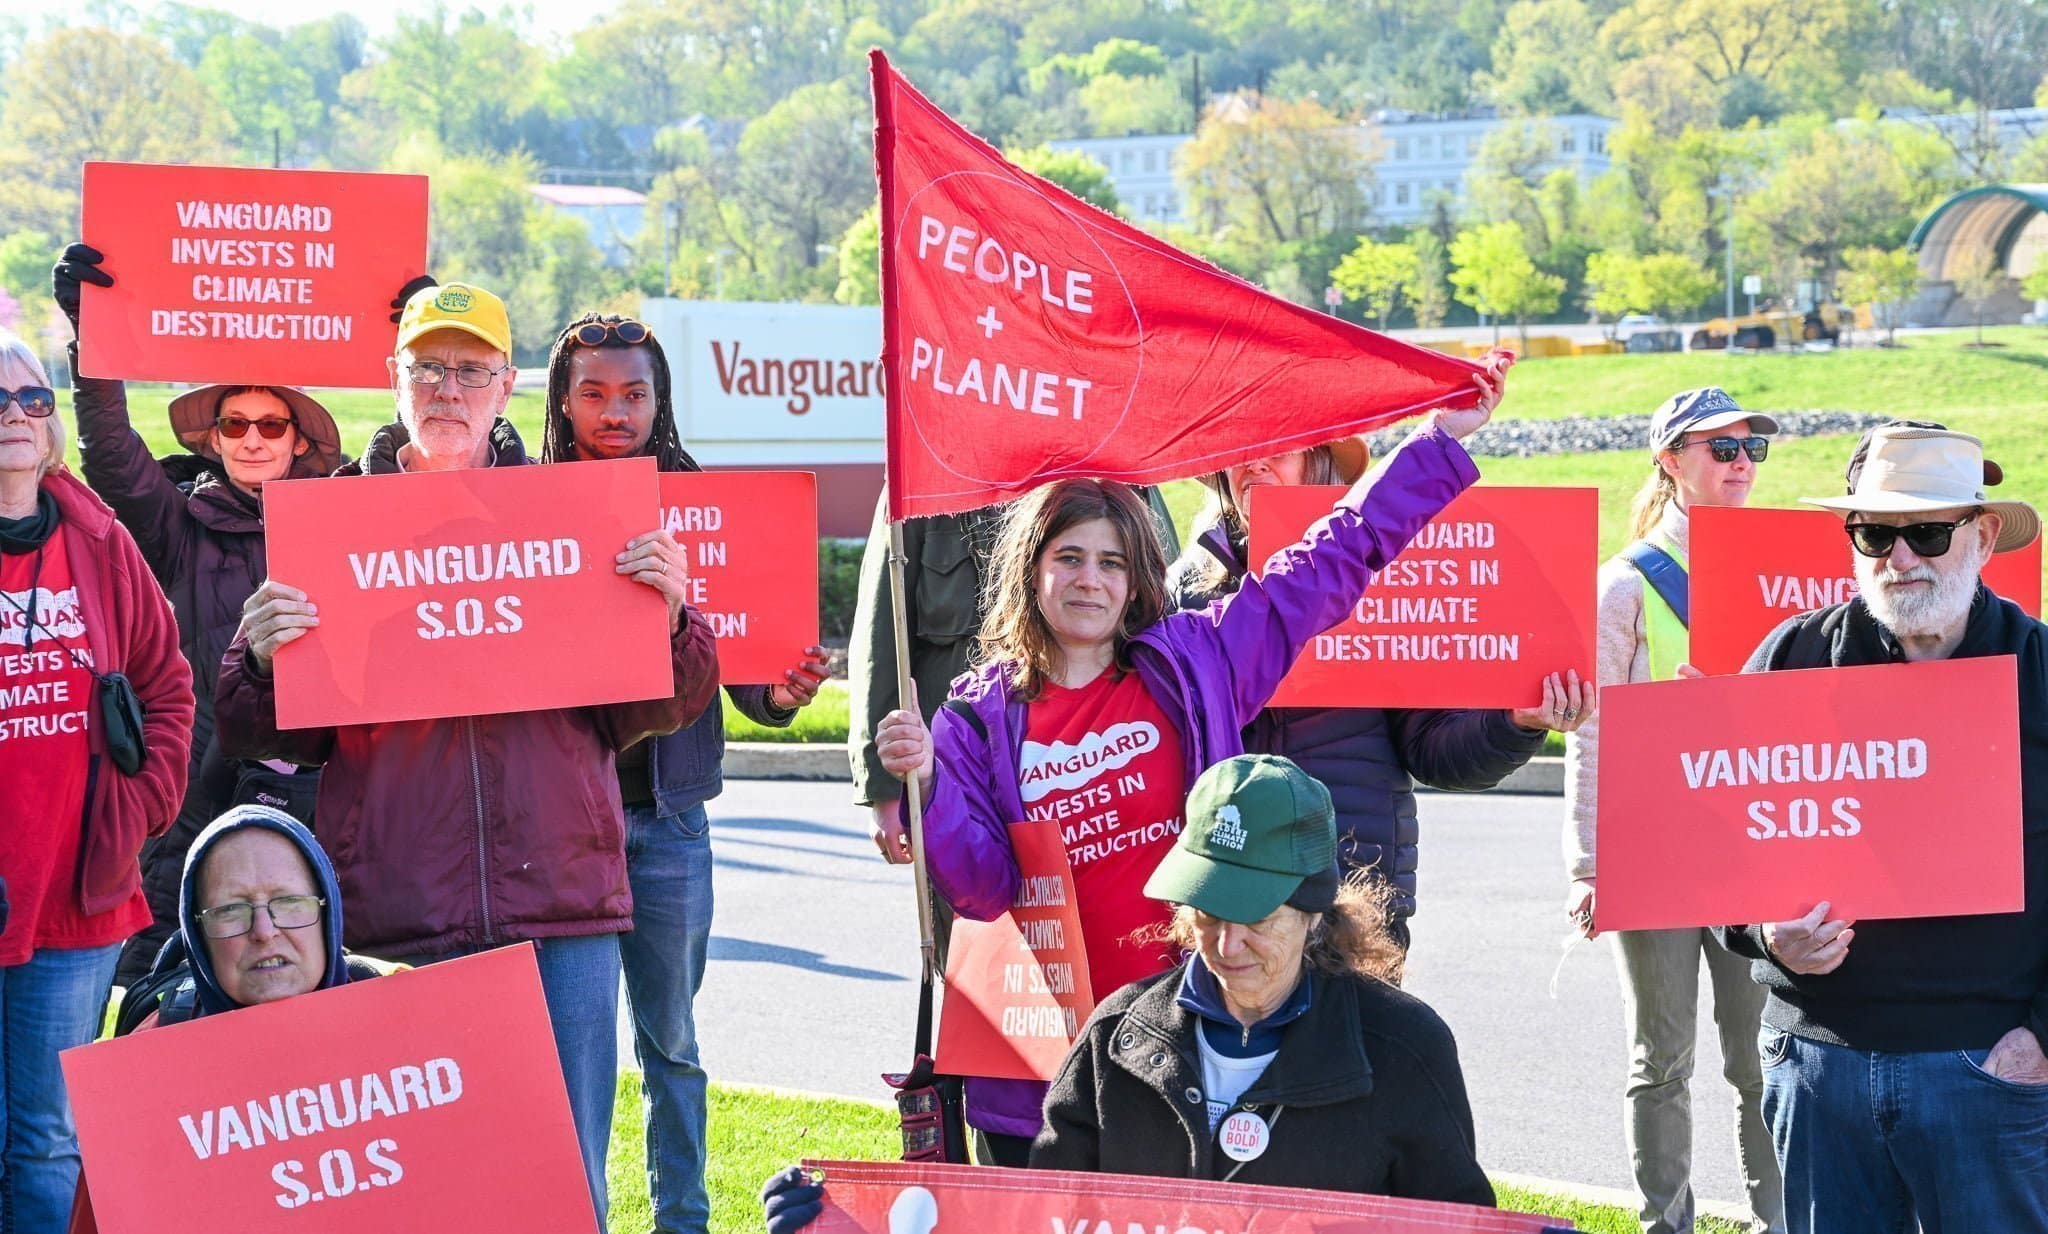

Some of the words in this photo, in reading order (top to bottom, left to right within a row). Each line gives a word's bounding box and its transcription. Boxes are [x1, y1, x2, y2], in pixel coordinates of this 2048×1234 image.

[176, 200, 332, 232] VANGUARD
[171, 238, 295, 268] INVESTS
[304, 242, 335, 269] IN
[918, 215, 1093, 314] PEOPLE
[192, 275, 313, 304] CLIMATE
[151, 310, 352, 342] DESTRUCTION
[910, 337, 1092, 420] PLANET
[660, 506, 722, 532] ARD
[1406, 522, 1495, 549] UARD
[348, 538, 581, 589] VANGUARD
[698, 541, 727, 567] IN
[1469, 559, 1499, 586] IN
[1758, 574, 1858, 609] VANG
[416, 595, 524, 640] S.O.S
[703, 611, 747, 638] ON
[1355, 596, 1478, 624] CLIMATE
[1, 650, 63, 677] ESTS
[70, 648, 96, 669] IN
[1315, 634, 1519, 662] DESTRUCTION
[0, 681, 69, 710] MATE
[0, 710, 89, 741] STRUCT
[1680, 738, 1927, 789] VANGUARD
[1117, 772, 1146, 797] IN
[1061, 810, 1121, 845] MATE
[1746, 797, 1862, 840] S.O.S
[1210, 836, 1244, 851] ACTION
[1212, 830, 1246, 844] CLIMATE
[1020, 919, 1065, 950] CLIMATE
[1003, 963, 1025, 993] IN
[1028, 962, 1075, 994] INVESTS
[1001, 1006, 1079, 1038] VANGUARD
[177, 1057, 464, 1160] VANGUARD
[1226, 1131, 1260, 1148] BOLD!
[1228, 1117, 1251, 1132] OLD
[271, 1138, 404, 1209] S.O.S
